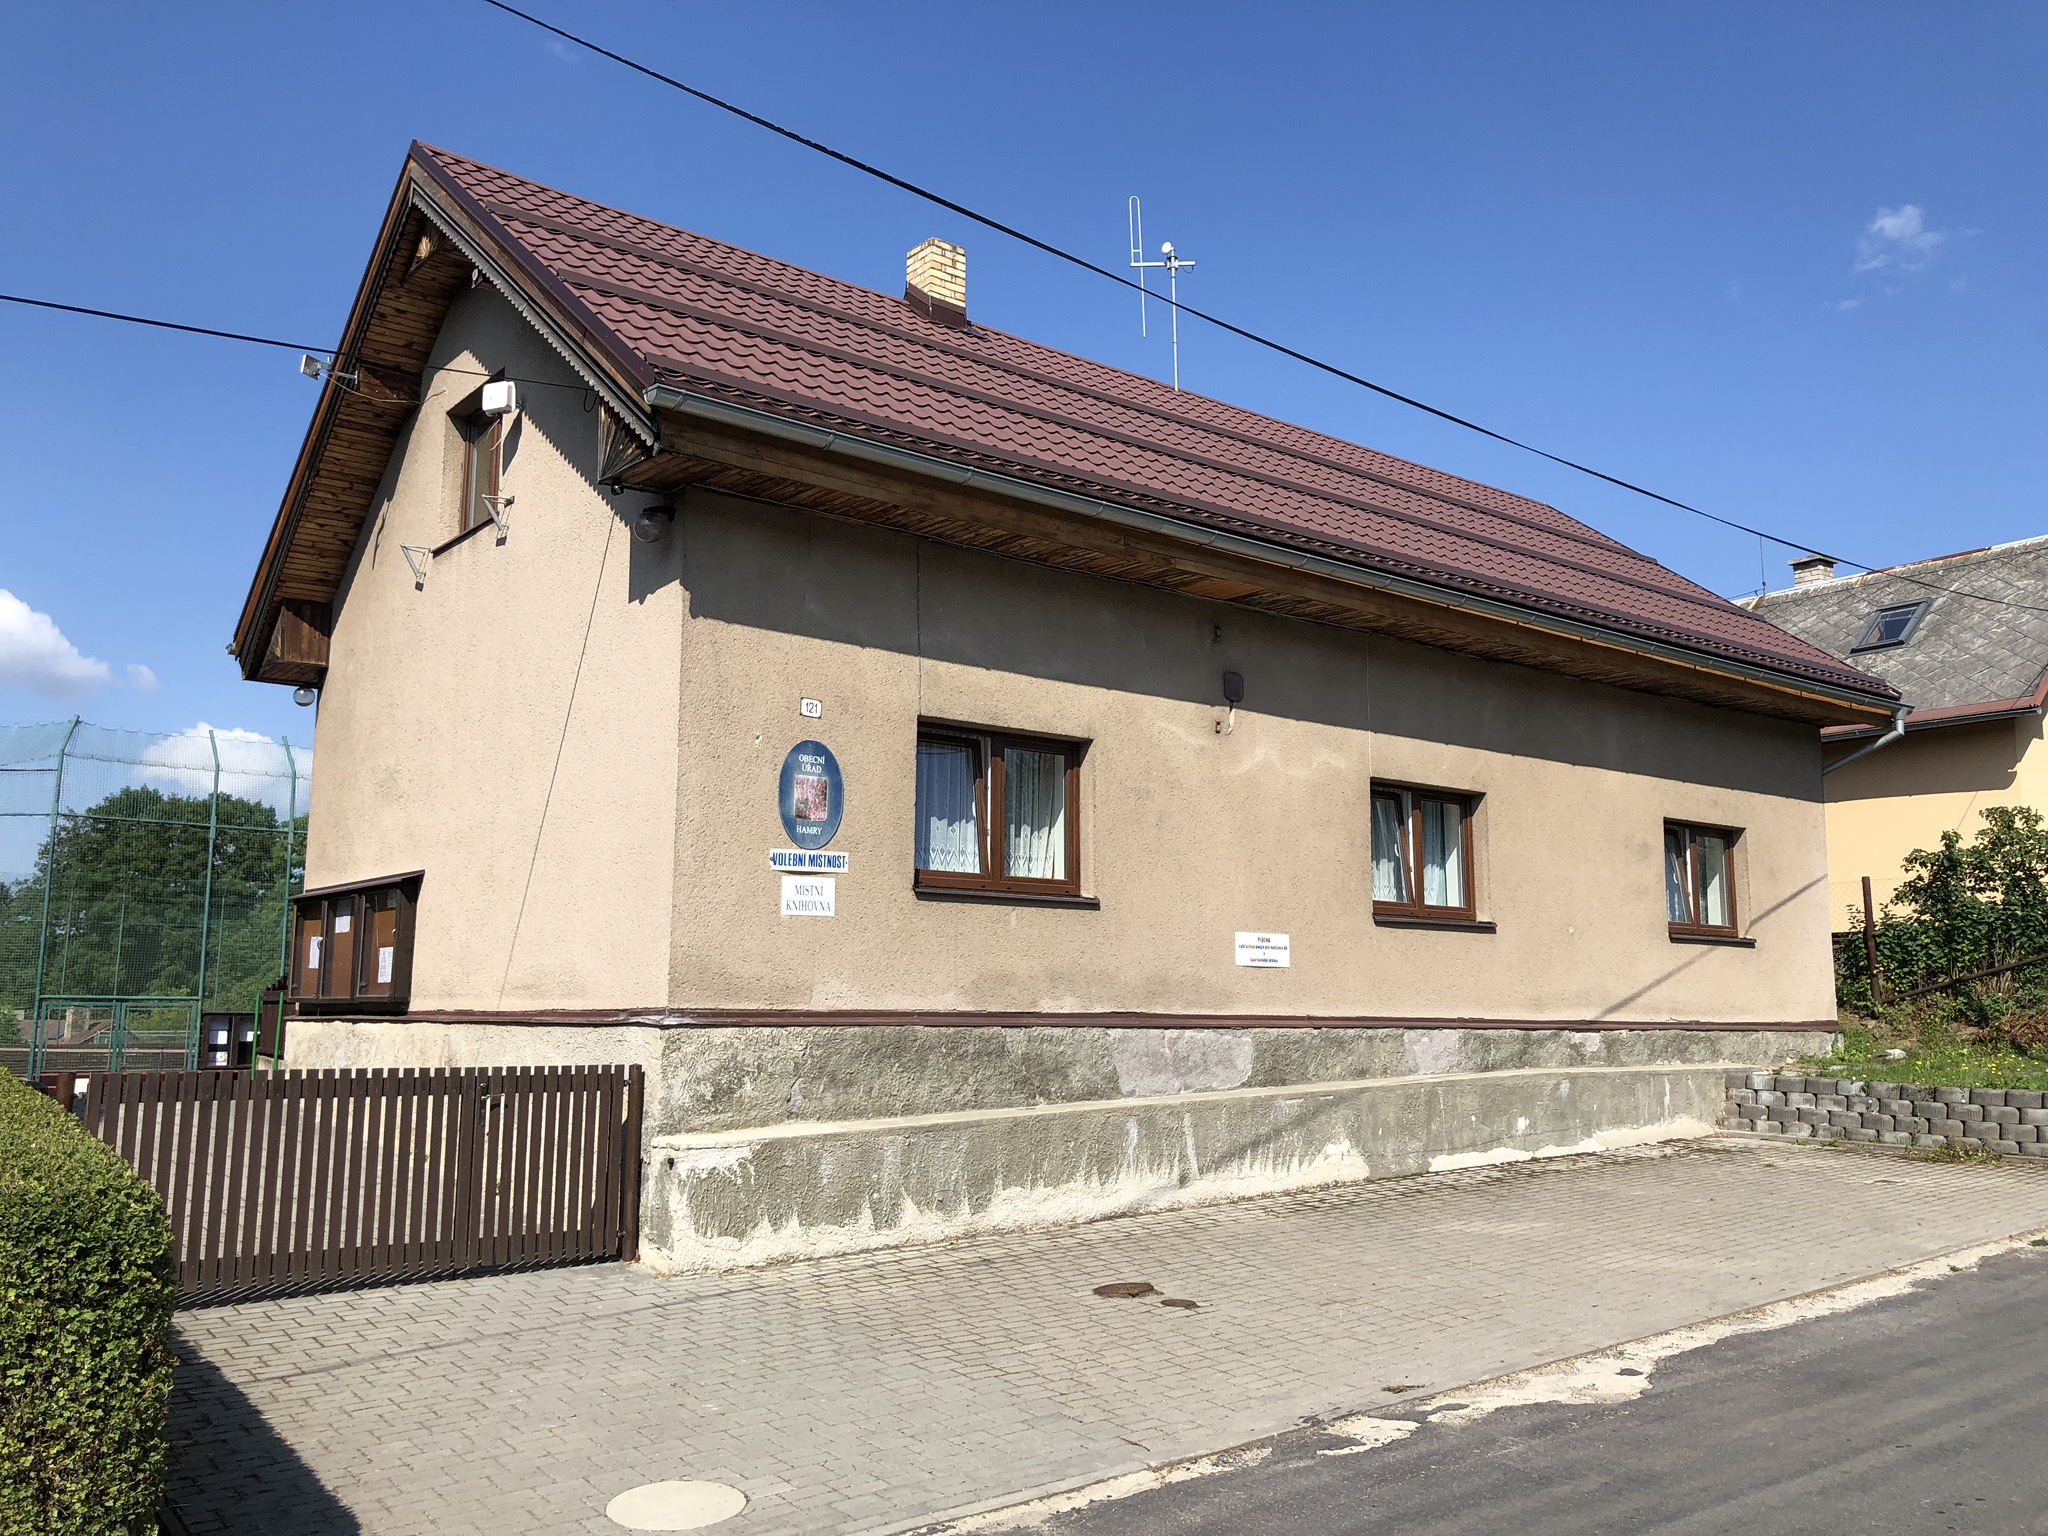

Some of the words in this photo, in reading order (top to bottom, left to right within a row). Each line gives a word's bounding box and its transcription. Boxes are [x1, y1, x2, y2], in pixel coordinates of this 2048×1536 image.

[805, 702, 818, 714] 121
[798, 754, 826, 765] OBECNÍ
[796, 825, 823, 835] HAMRY
[773, 850, 806, 866] VOLEBNÍ
[808, 852, 846, 869] MÍSTNOST
[794, 883, 824, 897] MÍSTNÍ
[786, 897, 831, 912] KNIHOVNA
